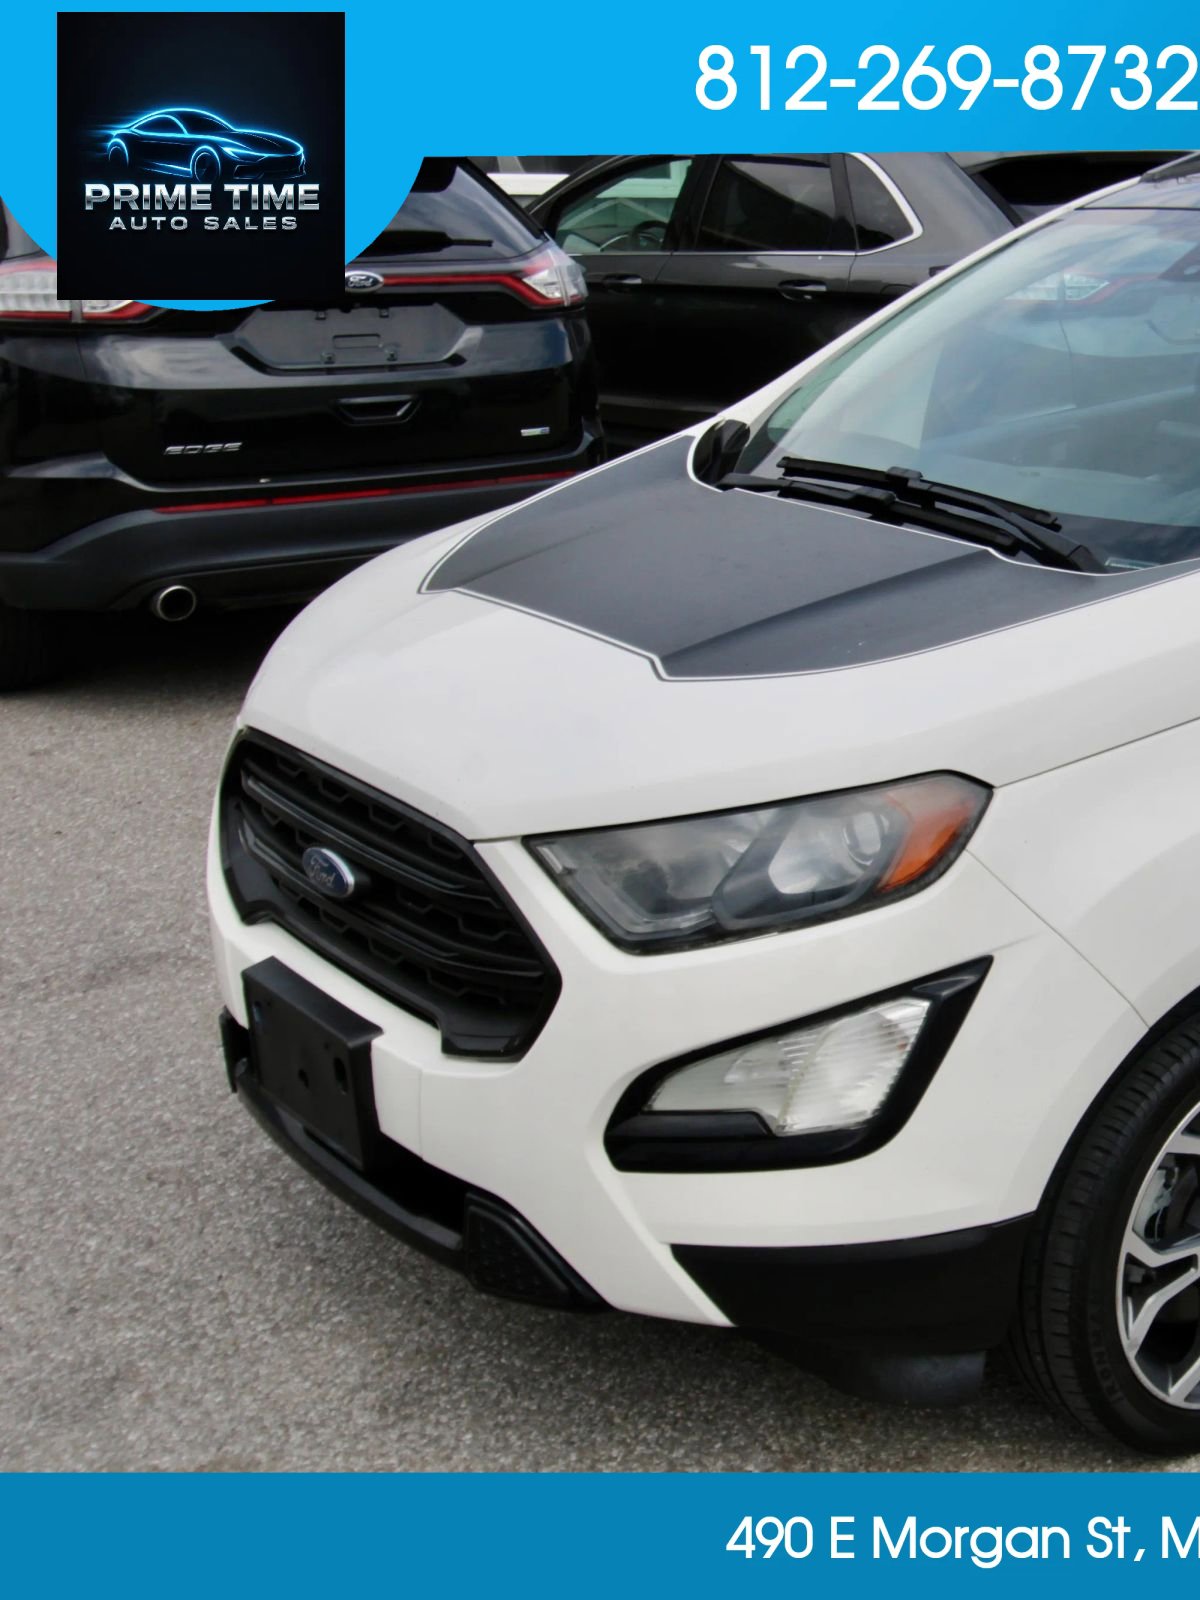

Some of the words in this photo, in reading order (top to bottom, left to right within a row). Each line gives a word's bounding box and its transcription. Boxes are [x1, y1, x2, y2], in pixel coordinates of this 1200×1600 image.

[348, 275, 373, 287] Ford
[163, 442, 243, 455] EDGE
[310, 854, 336, 889] Ford
